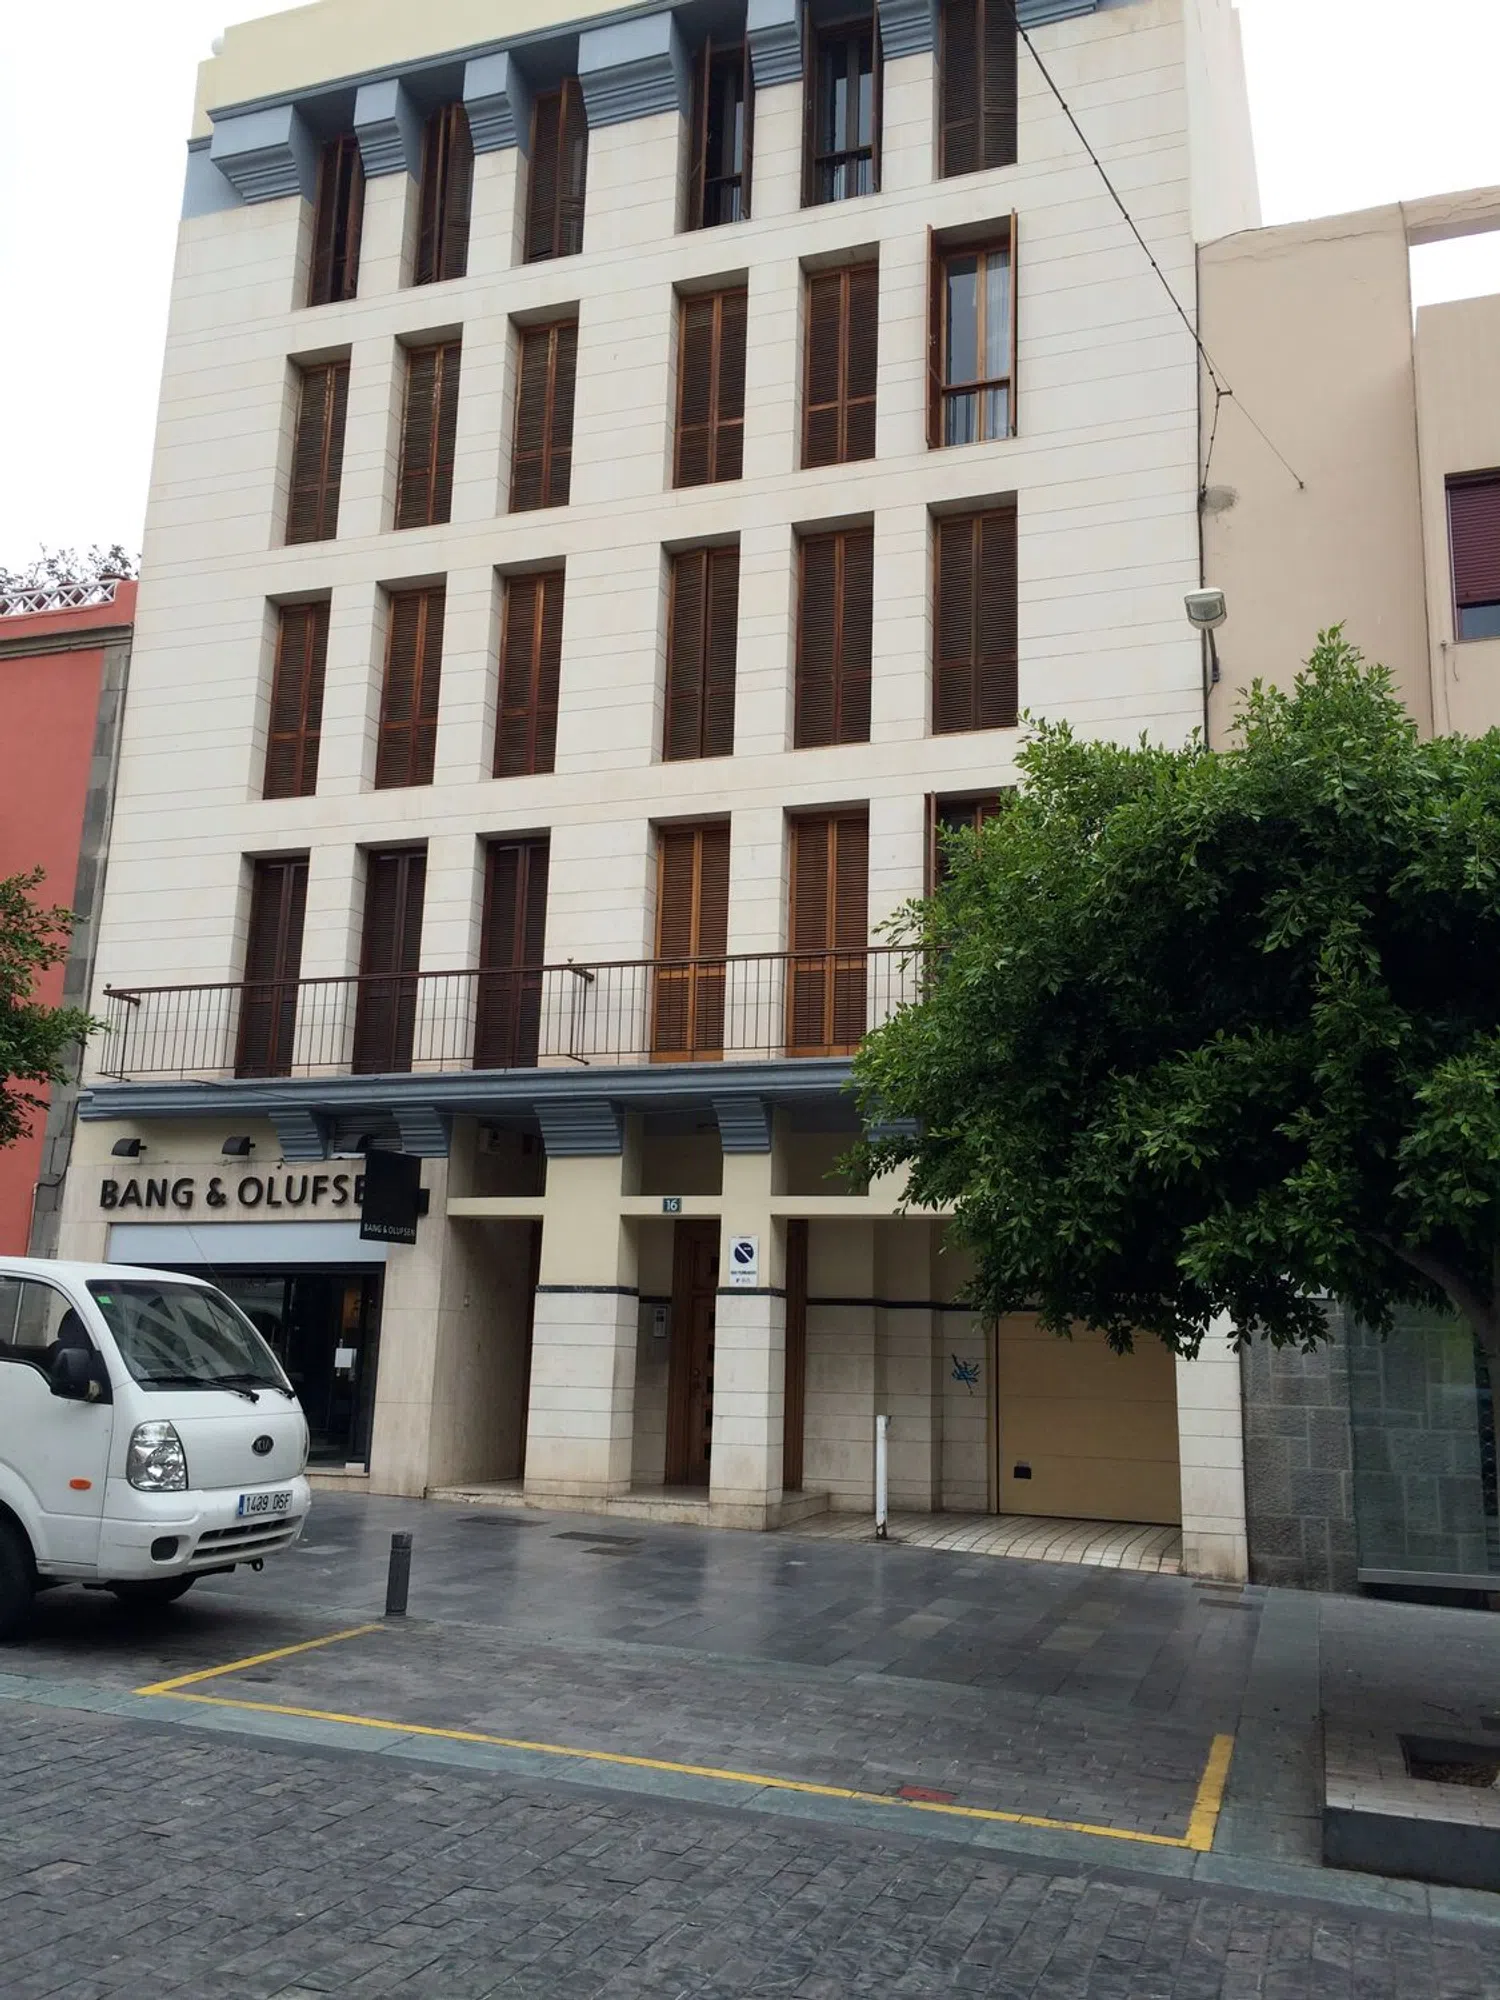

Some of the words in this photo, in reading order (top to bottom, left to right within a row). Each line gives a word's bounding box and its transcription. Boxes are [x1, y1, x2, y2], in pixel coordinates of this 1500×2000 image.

[99, 1177, 194, 1208] BANG
[205, 1176, 227, 1207] &
[666, 1199, 678, 1211] 16
[364, 1223, 381, 1233] BANG
[256, 1439, 271, 1450] KIA
